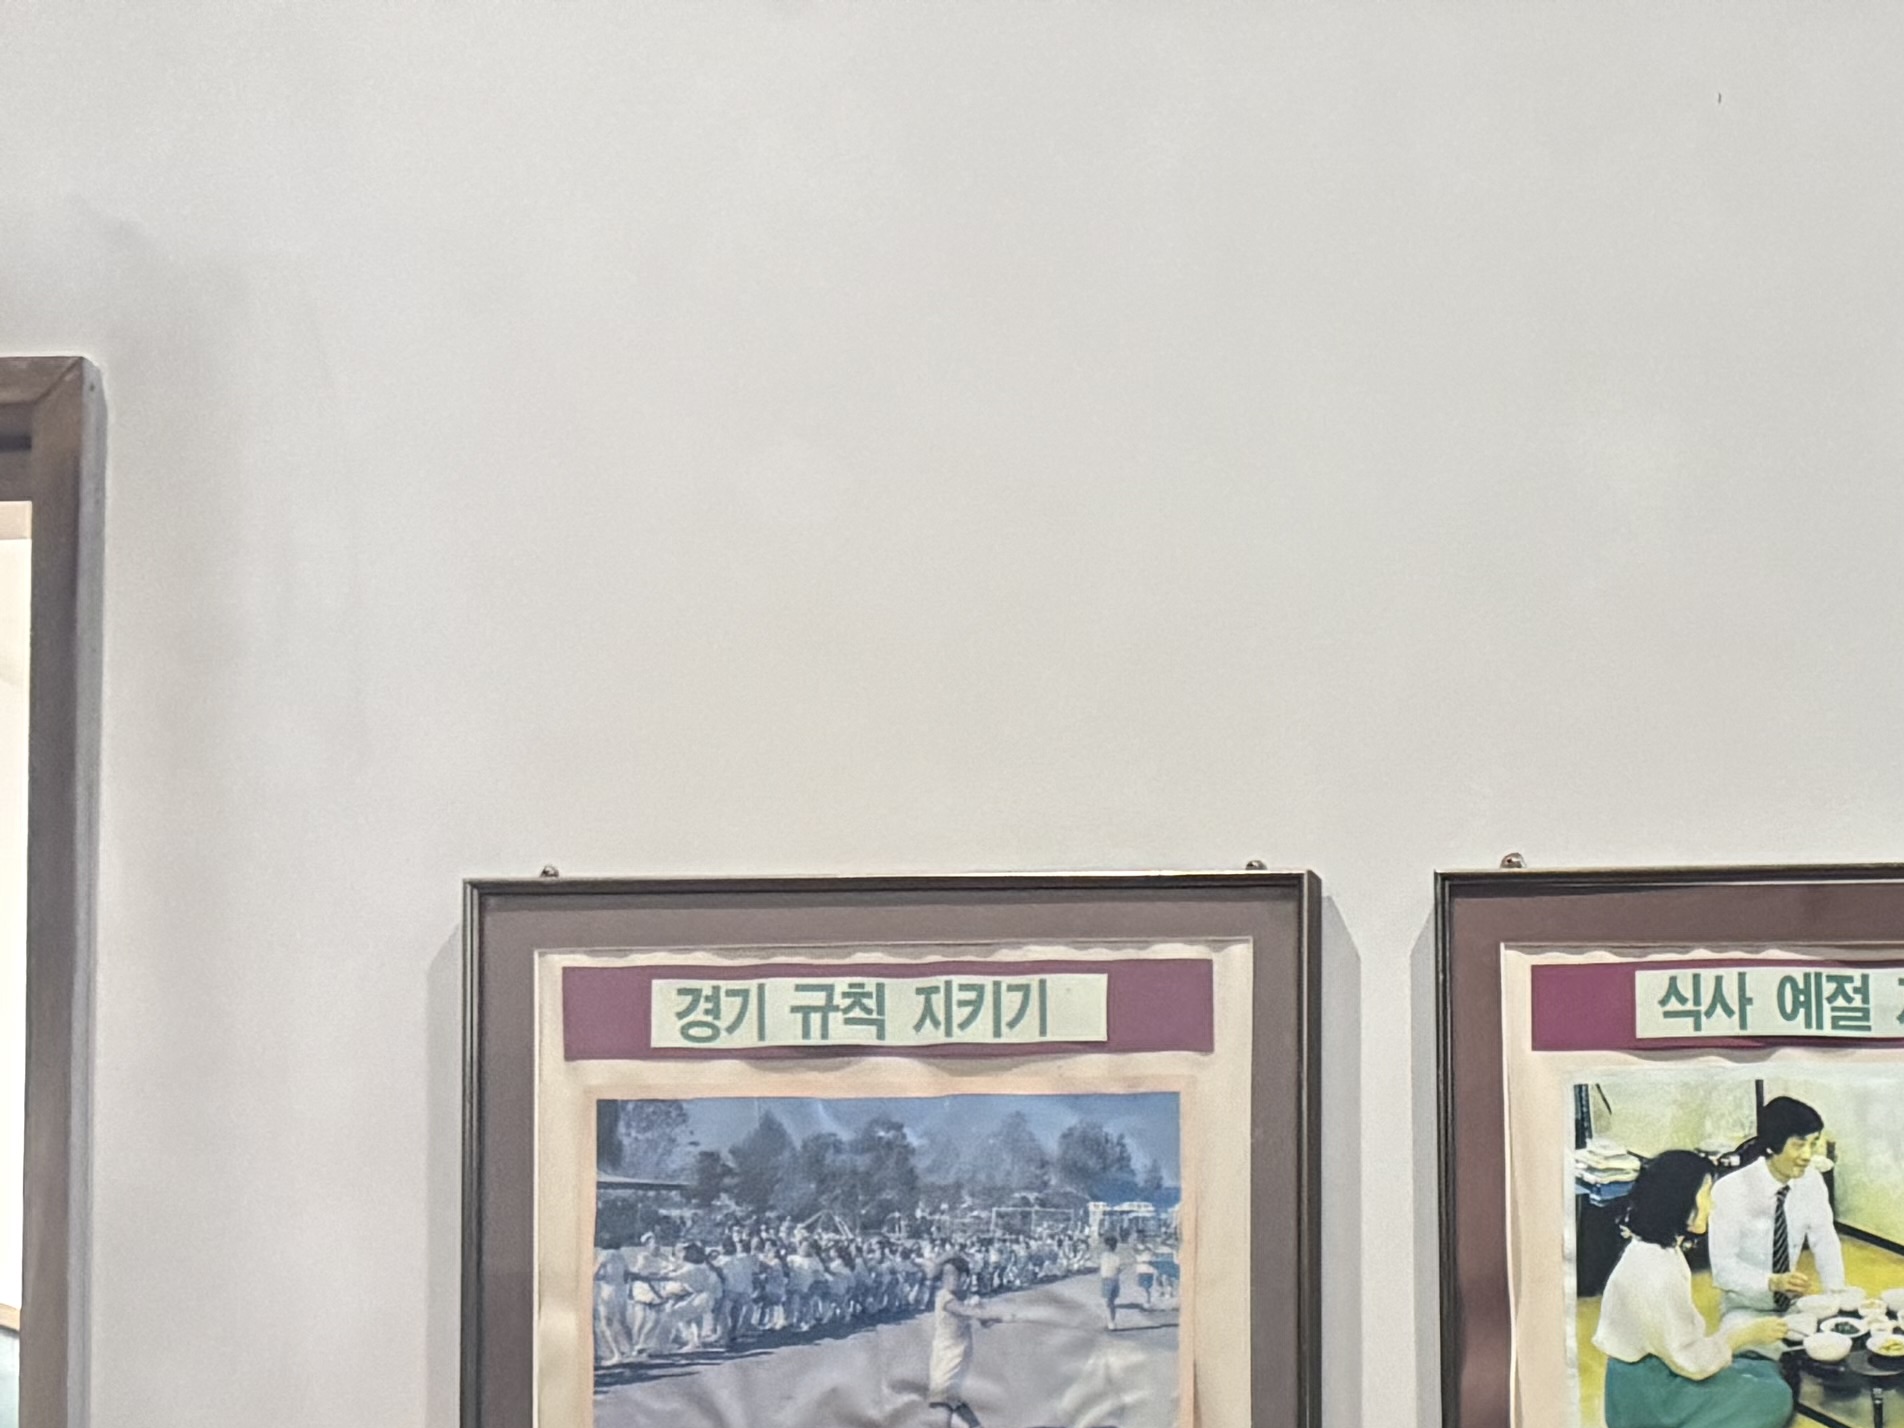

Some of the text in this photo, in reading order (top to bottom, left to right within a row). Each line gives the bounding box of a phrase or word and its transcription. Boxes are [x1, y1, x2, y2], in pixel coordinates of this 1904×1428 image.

[675, 978, 1048, 1044] 경기 규칙 지키기
[1657, 971, 1753, 1032] 식사
[1776, 971, 1872, 1032] 예절
